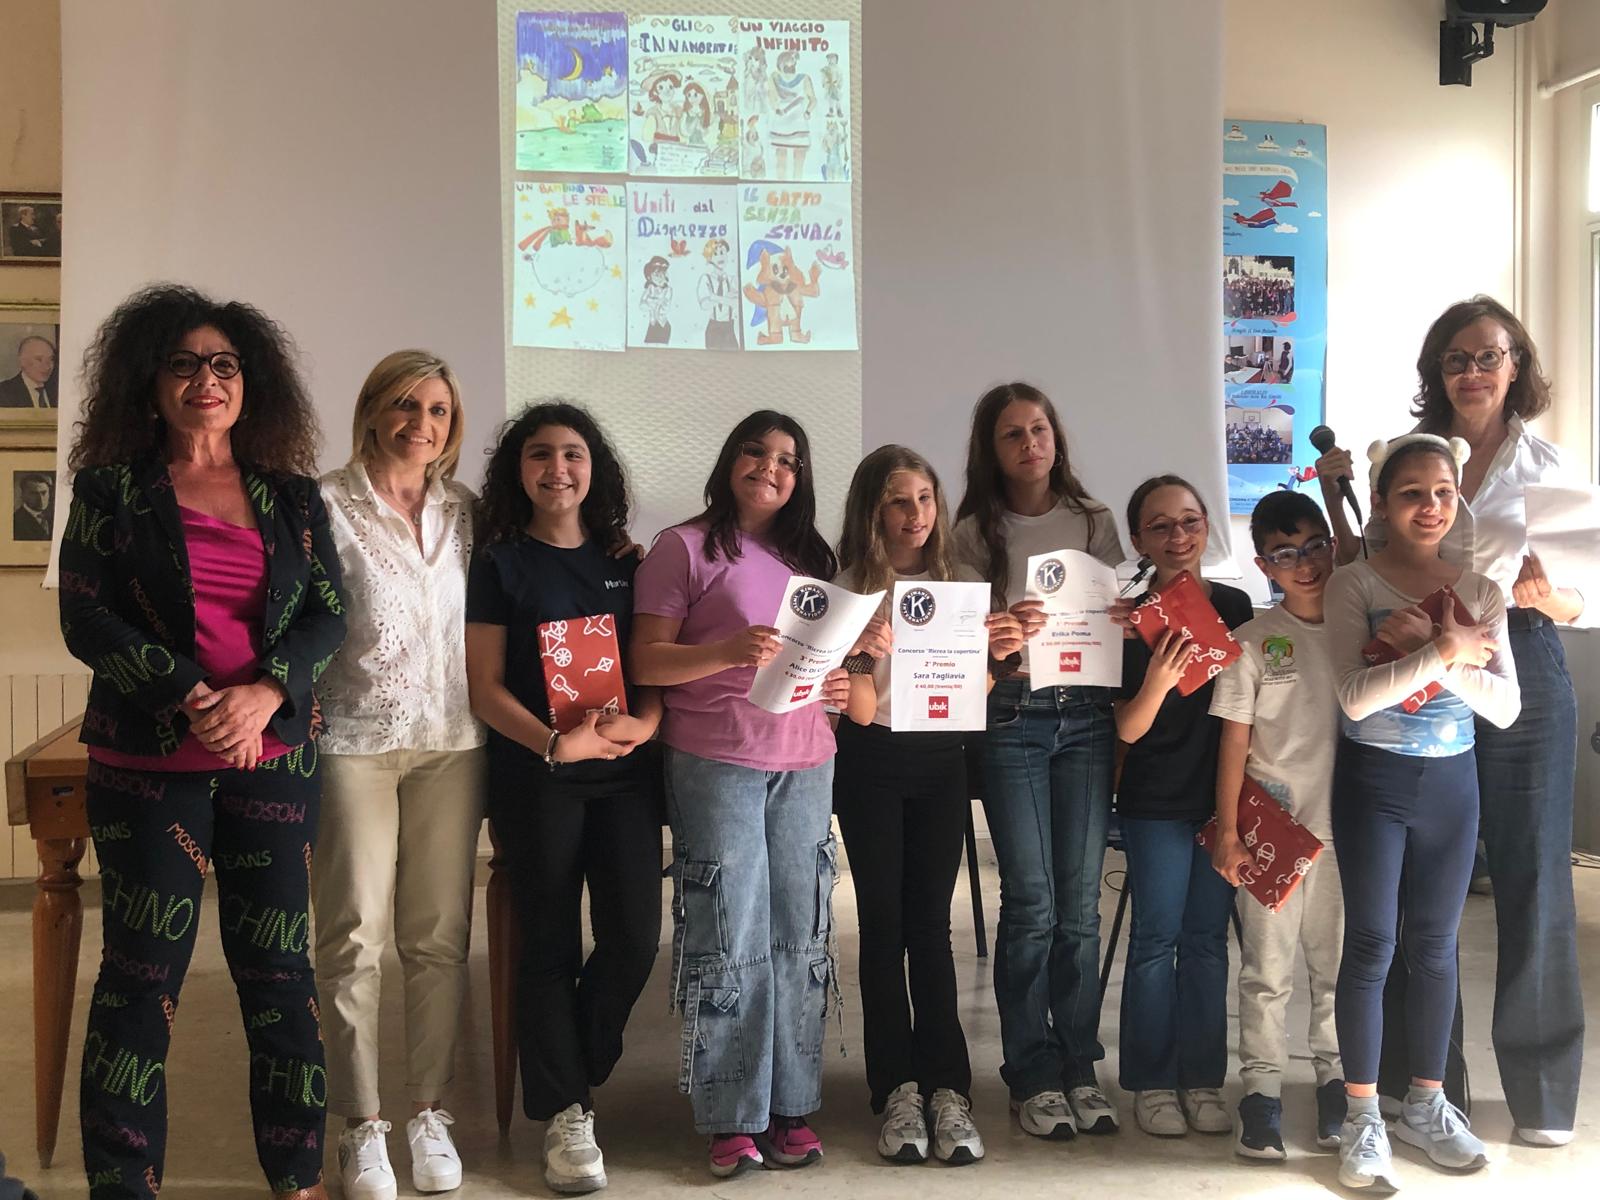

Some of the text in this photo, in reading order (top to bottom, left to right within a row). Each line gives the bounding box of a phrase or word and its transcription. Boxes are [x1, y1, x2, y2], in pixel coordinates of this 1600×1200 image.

[671, 18, 693, 32] GLI
[740, 21, 825, 33] UN VIAGGIO
[756, 36, 829, 52] INFINITO
[516, 184, 533, 193] UN
[538, 184, 585, 194] BAMBINO
[561, 193, 626, 208] LE STELLE
[633, 188, 715, 214] Uniti dal
[766, 190, 823, 207] GATTO
[743, 205, 802, 222] SENZA
[1043, 565, 1058, 587] K
[800, 590, 820, 613] K
[910, 595, 926, 618] K
[897, 647, 925, 655] Concorso
[789, 662, 808, 673] Alice
[913, 672, 966, 681] Sara Tagliavia
[929, 702, 948, 713] ubik
[100, 867, 194, 941] CHINO
